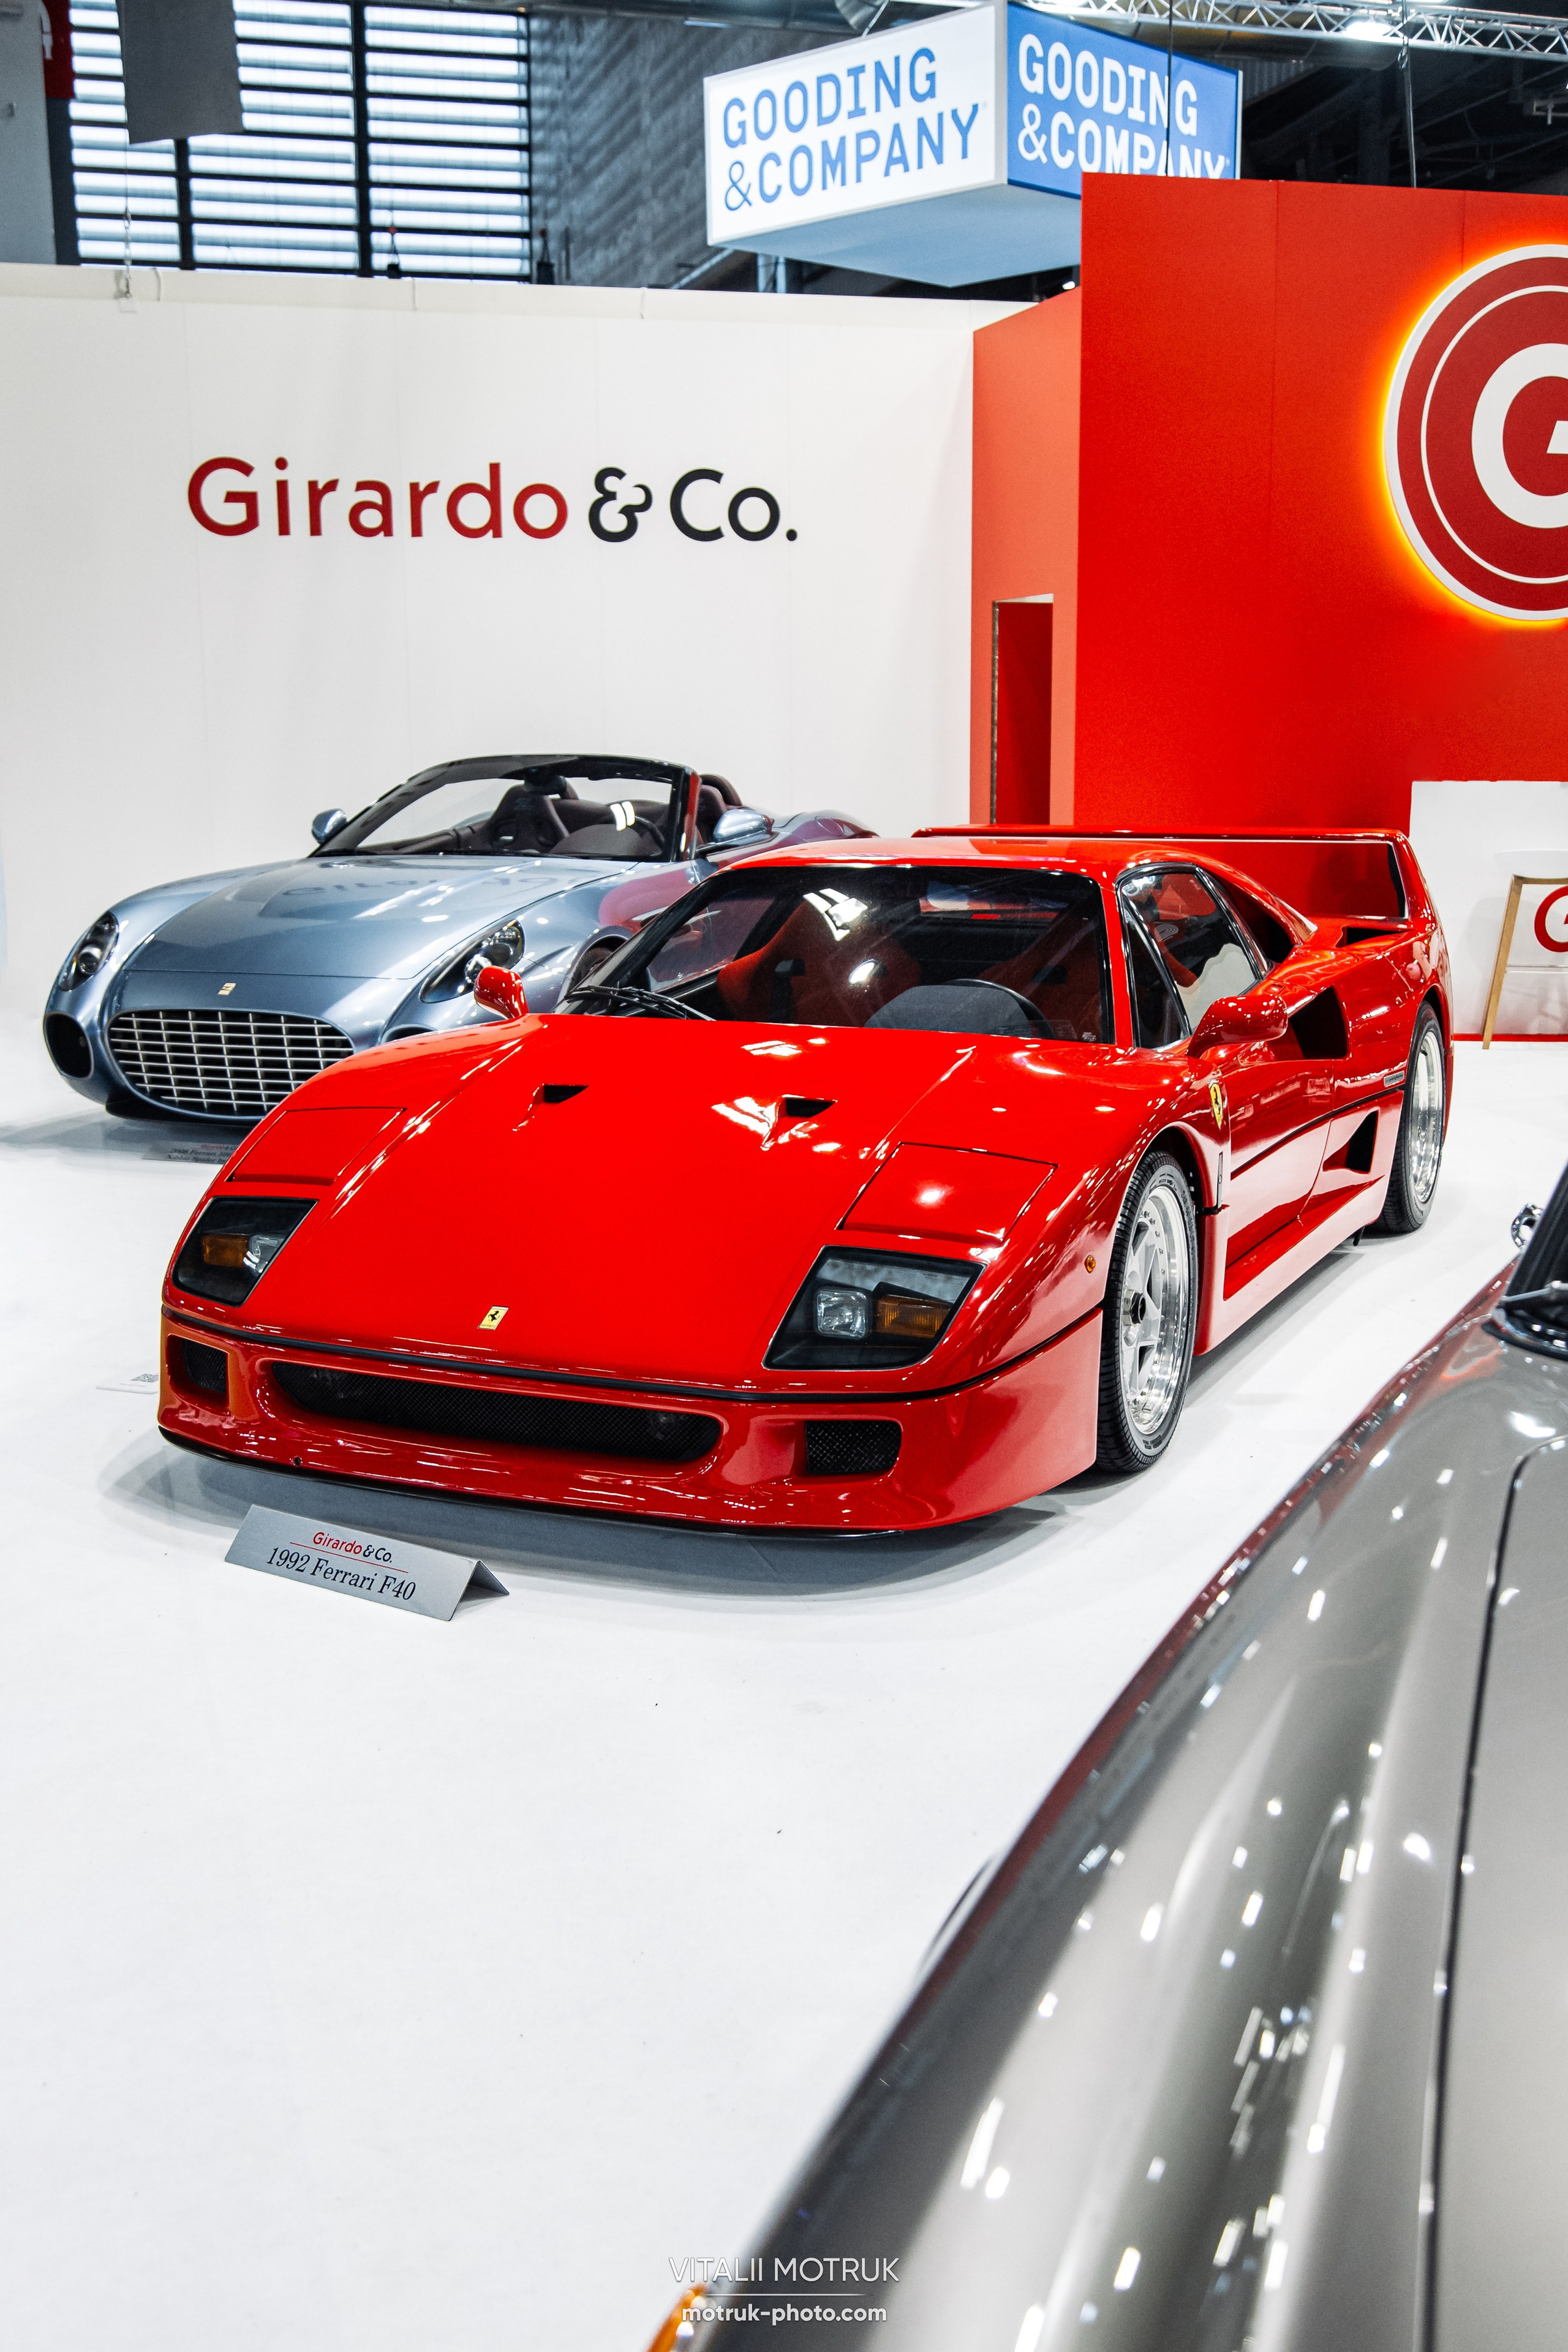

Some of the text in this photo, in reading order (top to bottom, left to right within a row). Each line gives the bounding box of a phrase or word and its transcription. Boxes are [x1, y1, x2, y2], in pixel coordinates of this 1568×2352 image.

[723, 47, 937, 148] GOODING
[1019, 33, 1198, 137] GOODING
[725, 103, 979, 212] &COMPANY
[187, 456, 798, 543] Girardo & Co.
[266, 1547, 417, 1600] 1992 Ferrari F40
[312, 1531, 363, 1555] Girardo
